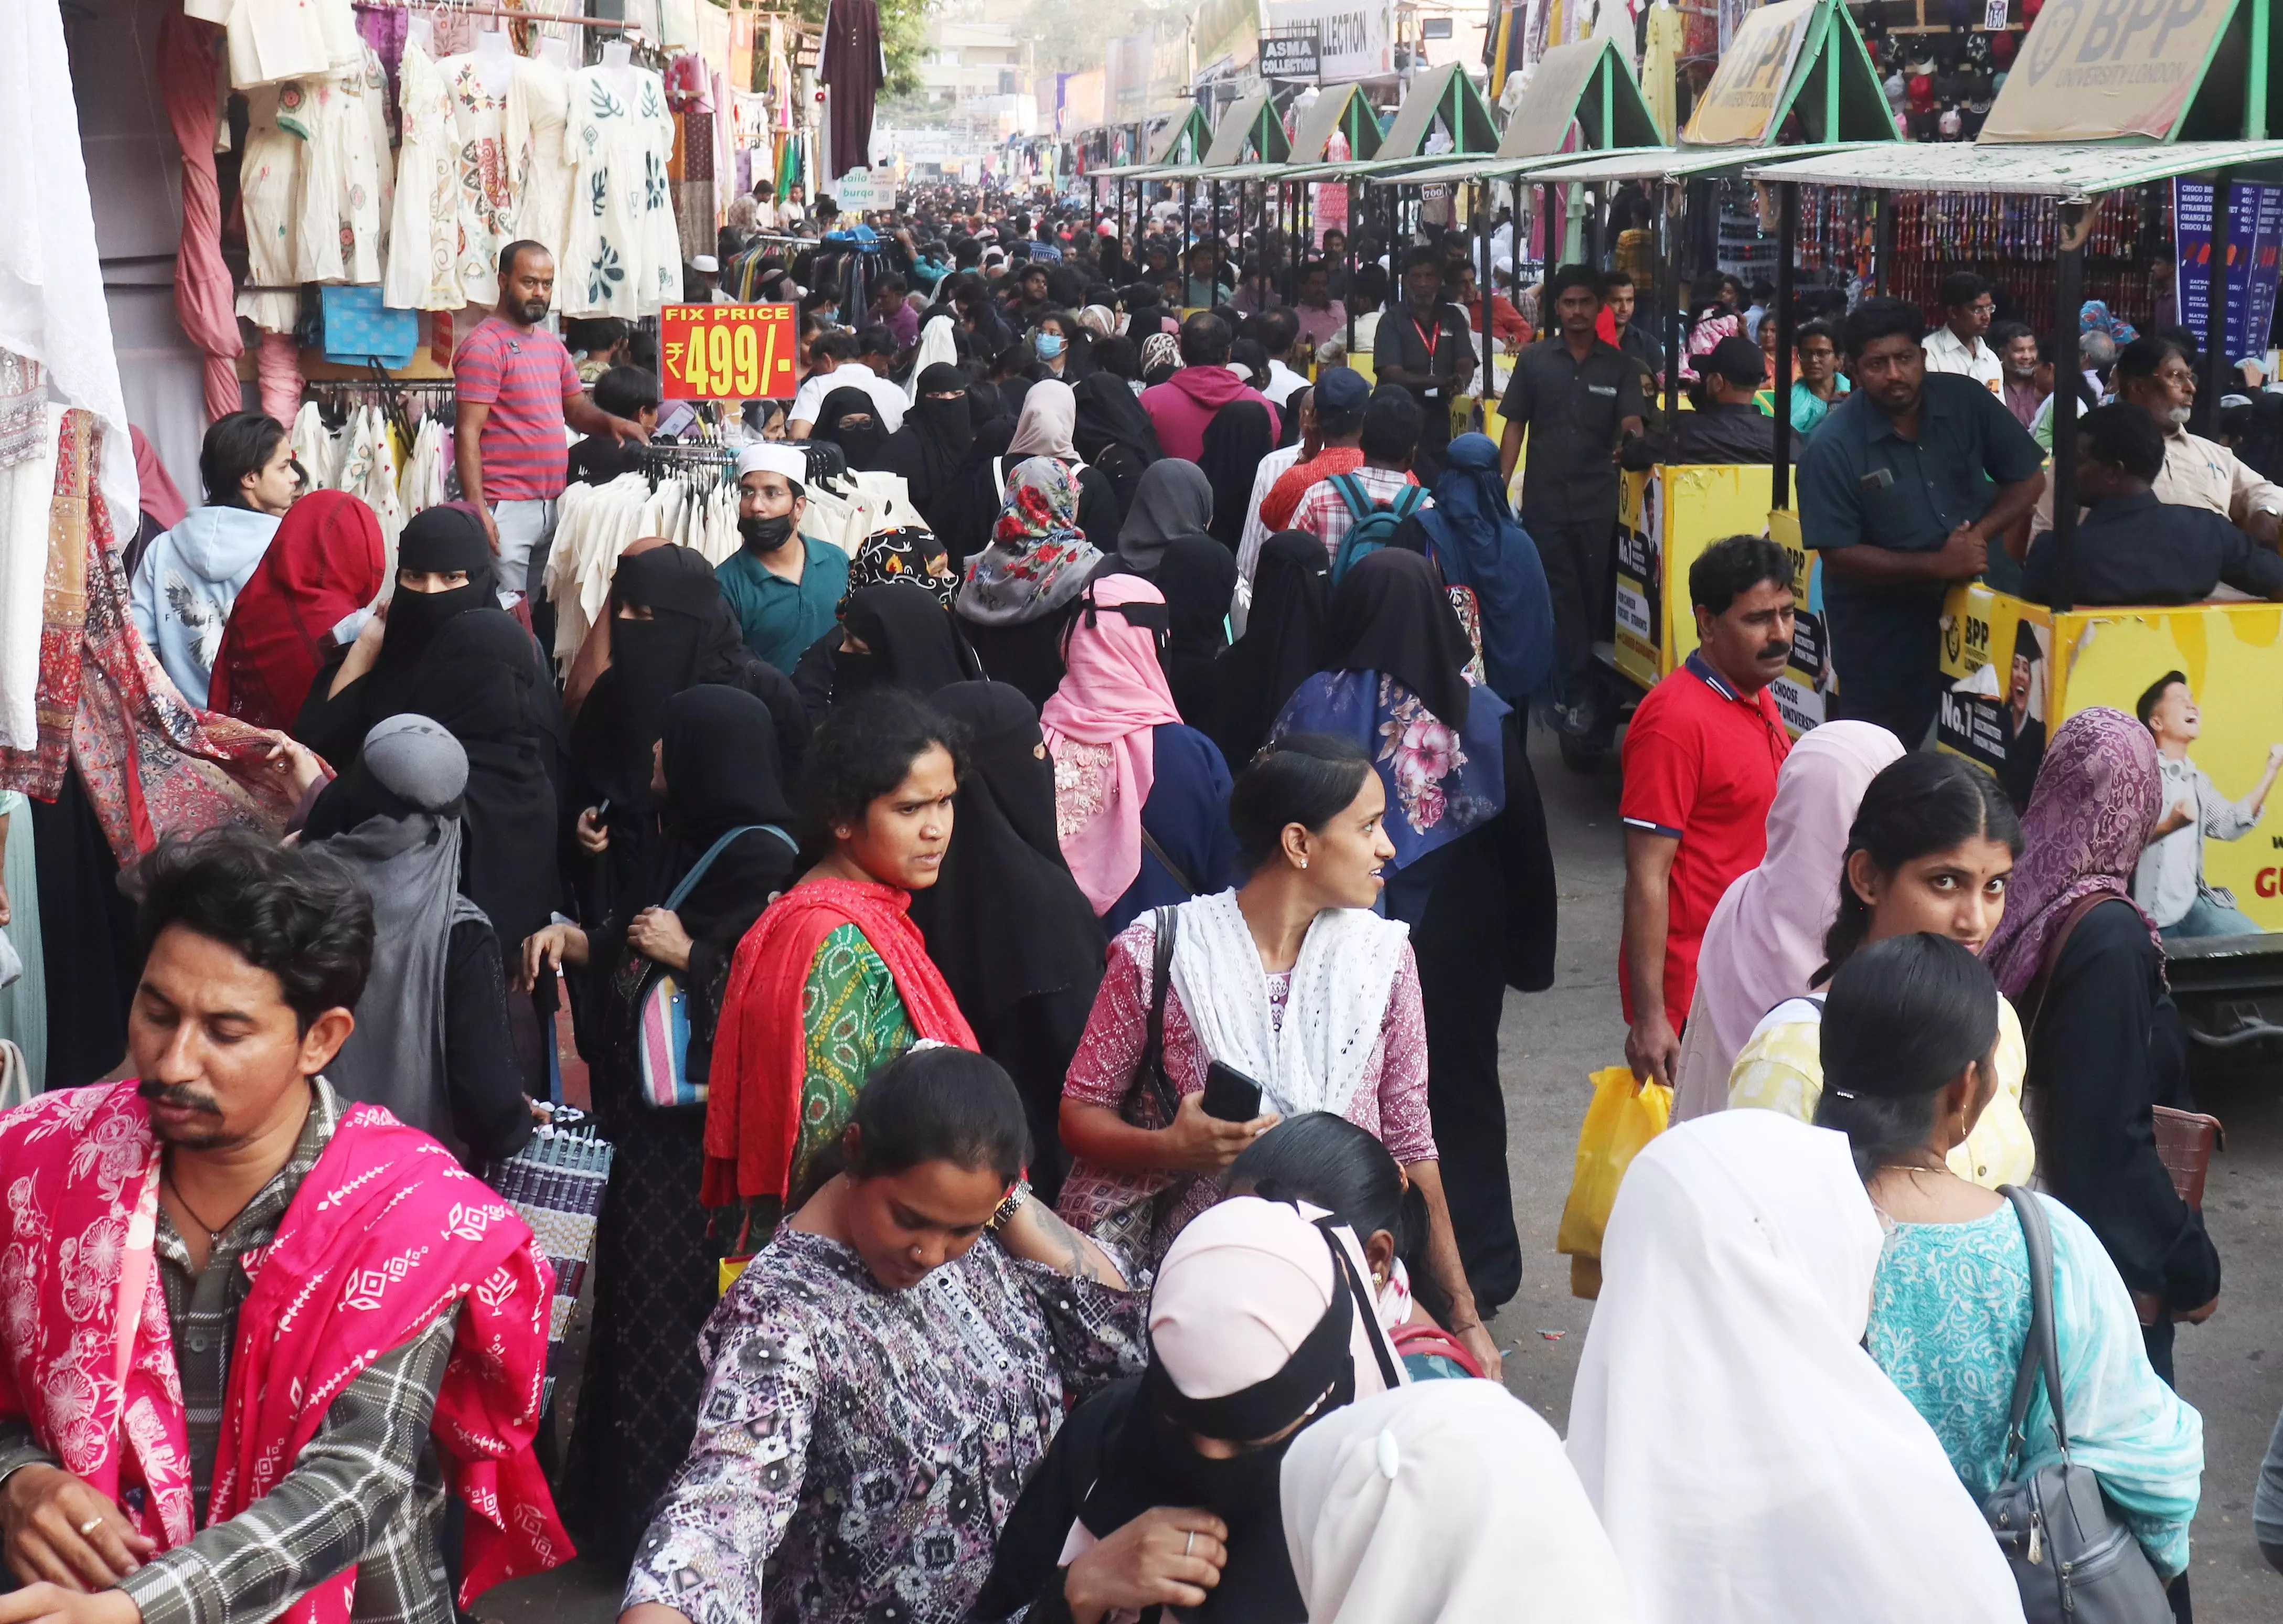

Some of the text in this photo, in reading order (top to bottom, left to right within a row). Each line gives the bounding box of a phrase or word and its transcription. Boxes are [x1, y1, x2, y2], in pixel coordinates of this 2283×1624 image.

[1988, 9, 2003, 27] 150
[2075, 0, 2206, 63] BPP
[1265, 41, 1312, 58] ASMA
[1262, 57, 1317, 74] COLLECTION
[843, 188, 874, 199] burqa
[1425, 188, 1442, 198] 700
[2181, 213, 2205, 221] ORANGE
[2241, 216, 2254, 225] 40/-
[2180, 222, 2201, 231] CHOCO
[665, 307, 790, 321] FIX PRICE
[1619, 536, 1632, 566] No.1
[1965, 615, 1989, 651] BPP
[1774, 680, 1798, 706] CHOOSE
[1941, 690, 1972, 739] No.1
